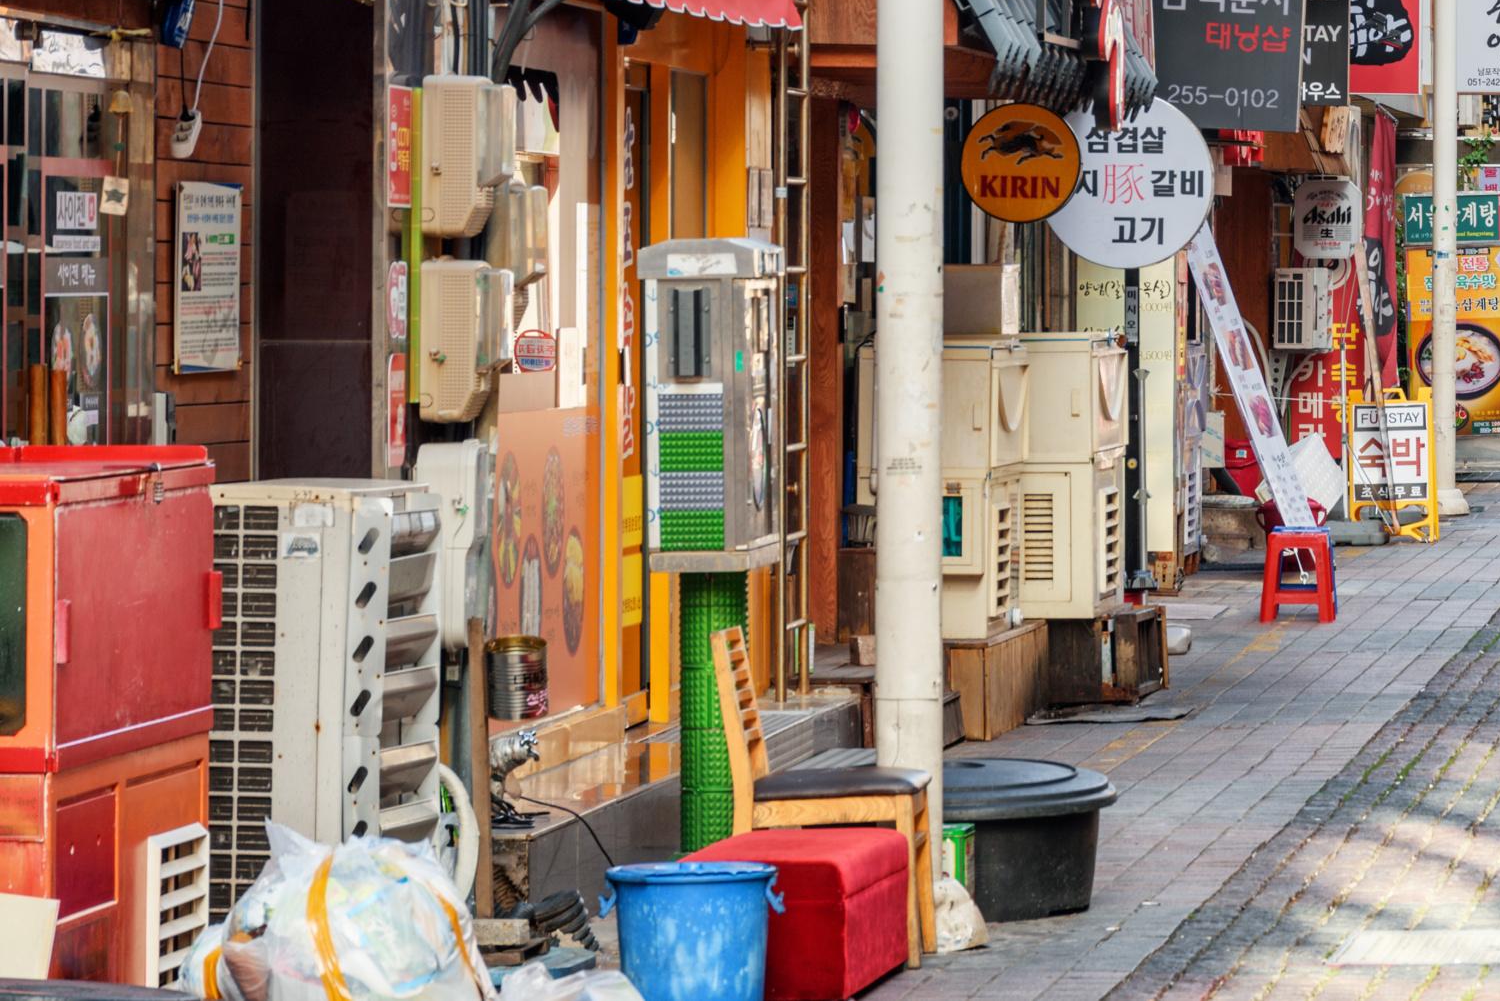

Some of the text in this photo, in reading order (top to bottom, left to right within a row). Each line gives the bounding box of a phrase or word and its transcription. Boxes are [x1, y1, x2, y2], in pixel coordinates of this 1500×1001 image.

[1204, 21, 1292, 54] 태닝샵
[1166, 83, 1280, 110] 255-0102
[1084, 125, 1167, 154] 삼겹살
[980, 174, 1061, 200] KIRIN
[1102, 163, 1146, 205] 豚
[1150, 169, 1204, 198] 갈비
[1302, 205, 1352, 225] Asahi
[1406, 200, 1497, 230] 서계탕
[1111, 216, 1165, 246] 고기
[1320, 227, 1334, 239] 生
[1462, 256, 1489, 273] 전통
[1126, 288, 1138, 330] 미시오
[1358, 436, 1426, 479] 숙박
